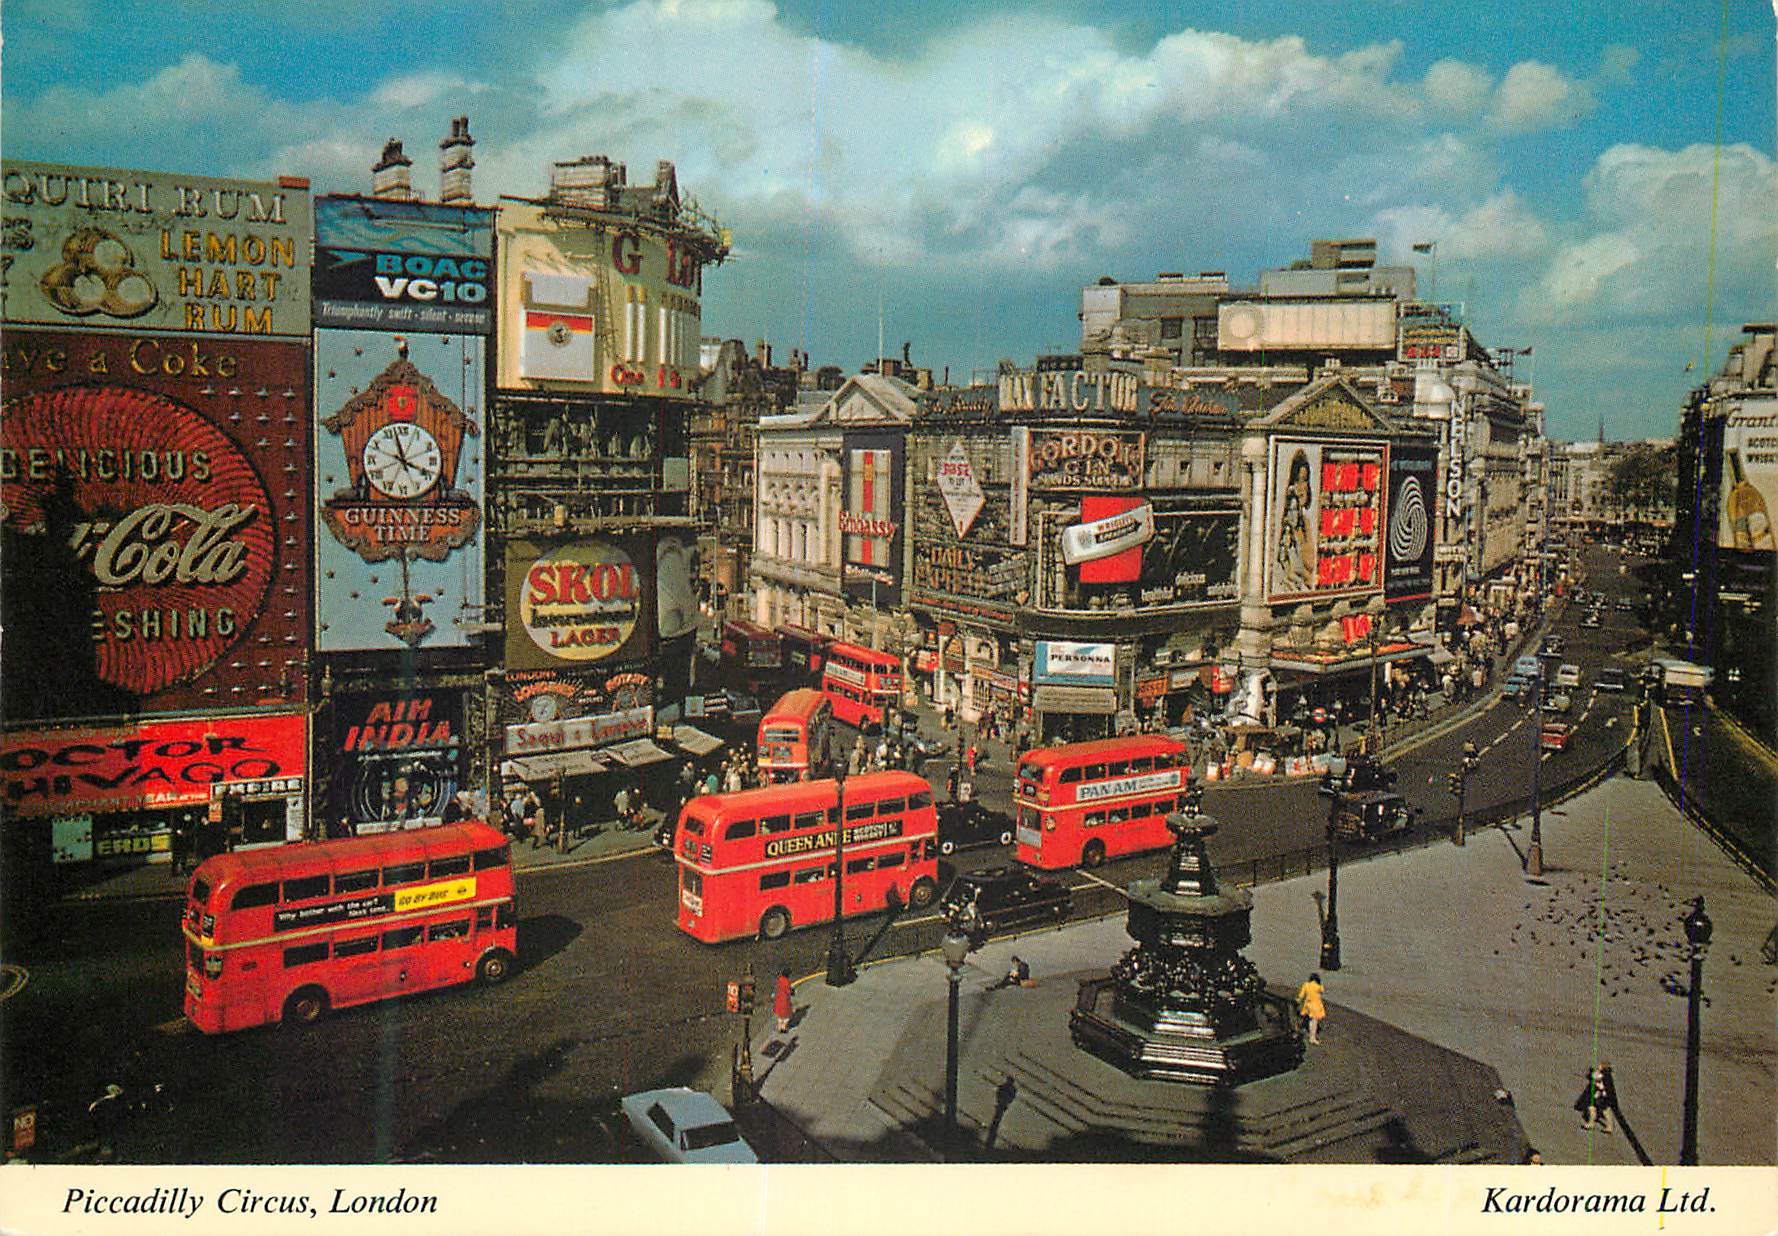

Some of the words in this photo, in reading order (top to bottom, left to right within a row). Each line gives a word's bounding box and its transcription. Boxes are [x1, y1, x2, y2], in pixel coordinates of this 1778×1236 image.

[173, 187, 288, 224] RUM
[159, 229, 296, 268] LEMON
[376, 253, 487, 278] BOAC
[179, 267, 283, 302] HART
[374, 276, 487, 303] VC10
[185, 303, 273, 336] RUM
[89, 350, 110, 374] a
[130, 338, 237, 378] Coke
[343, 507, 461, 527] GUINNESS
[94, 503, 257, 585] Cola
[373, 524, 430, 544] TIME
[528, 561, 640, 604] SKOL
[550, 627, 620, 648] LAGER
[1051, 653, 1111, 663] PERSONNA
[366, 697, 432, 724] AIR
[344, 719, 449, 751] INDIA
[0, 736, 270, 774] OCTOR
[4, 758, 281, 800] HIVAGO
[1080, 785, 1111, 799] PAN
[767, 835, 813, 856] QUEEN
